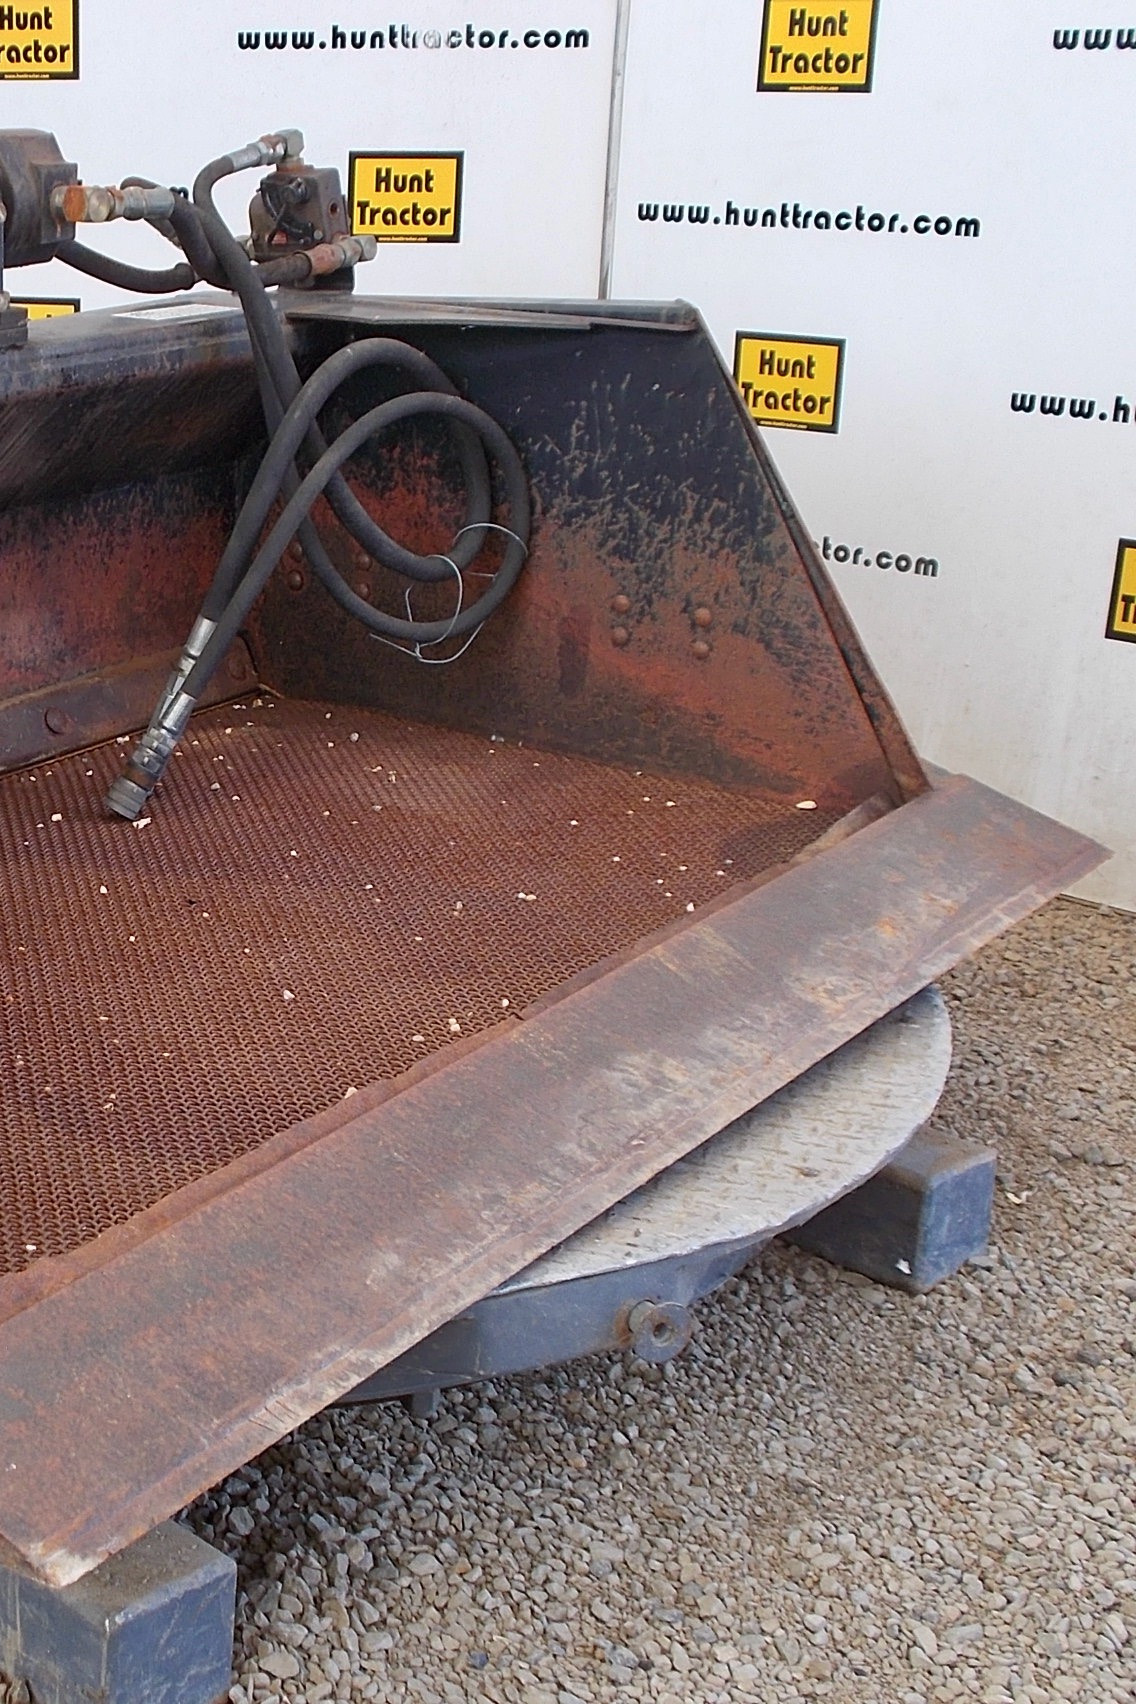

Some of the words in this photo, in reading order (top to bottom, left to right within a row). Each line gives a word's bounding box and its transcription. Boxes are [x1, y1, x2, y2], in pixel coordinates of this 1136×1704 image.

[788, 8, 848, 37] Hunt
[769, 45, 864, 74] Tractor
[375, 167, 434, 193] Hunt
[357, 200, 451, 226] Tractor
[637, 201, 981, 238] www.hunttractor.com
[759, 349, 816, 379] Hunt
[741, 381, 832, 415] Tractor
[1010, 392, 1136, 423] www.h
[814, 536, 939, 577] tor.com
